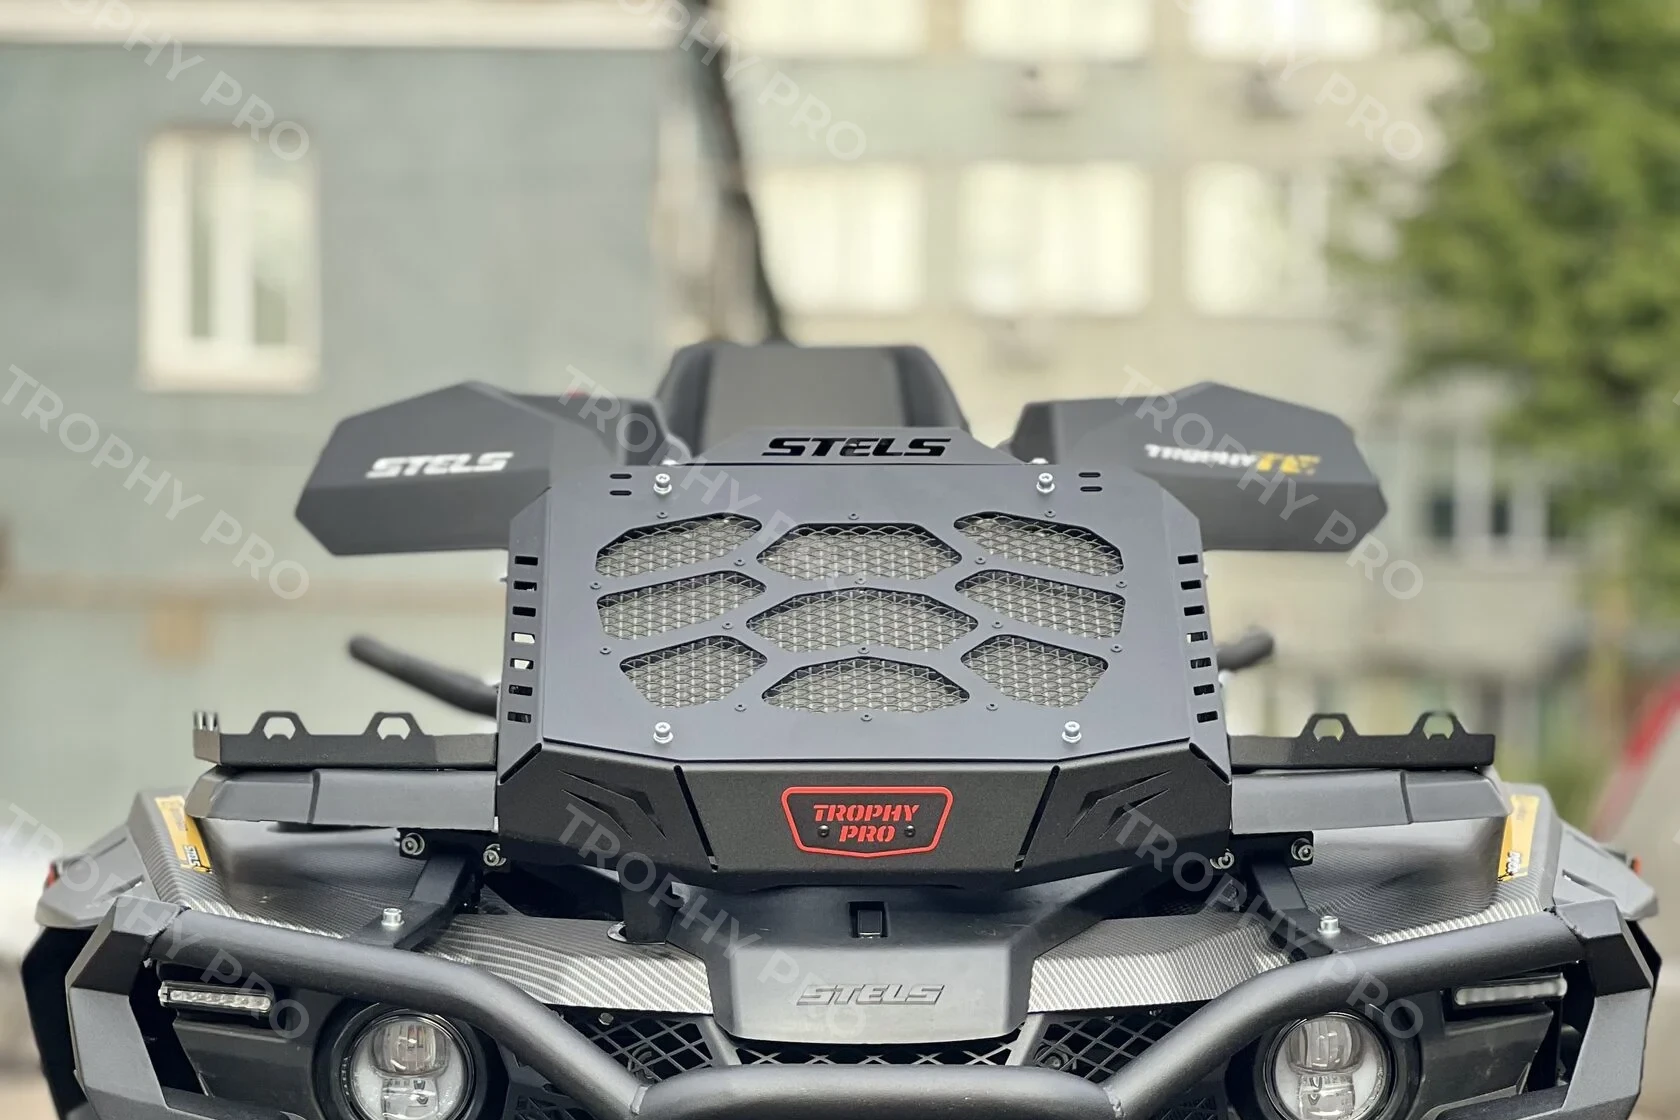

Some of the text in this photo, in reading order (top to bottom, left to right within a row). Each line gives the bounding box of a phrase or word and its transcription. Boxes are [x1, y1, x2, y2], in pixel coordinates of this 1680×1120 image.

[761, 437, 951, 457] STELS
[365, 451, 514, 479] STELS
[813, 804, 920, 822] TROPHY
[839, 825, 896, 843] PRO
[796, 983, 946, 1006] STELS
